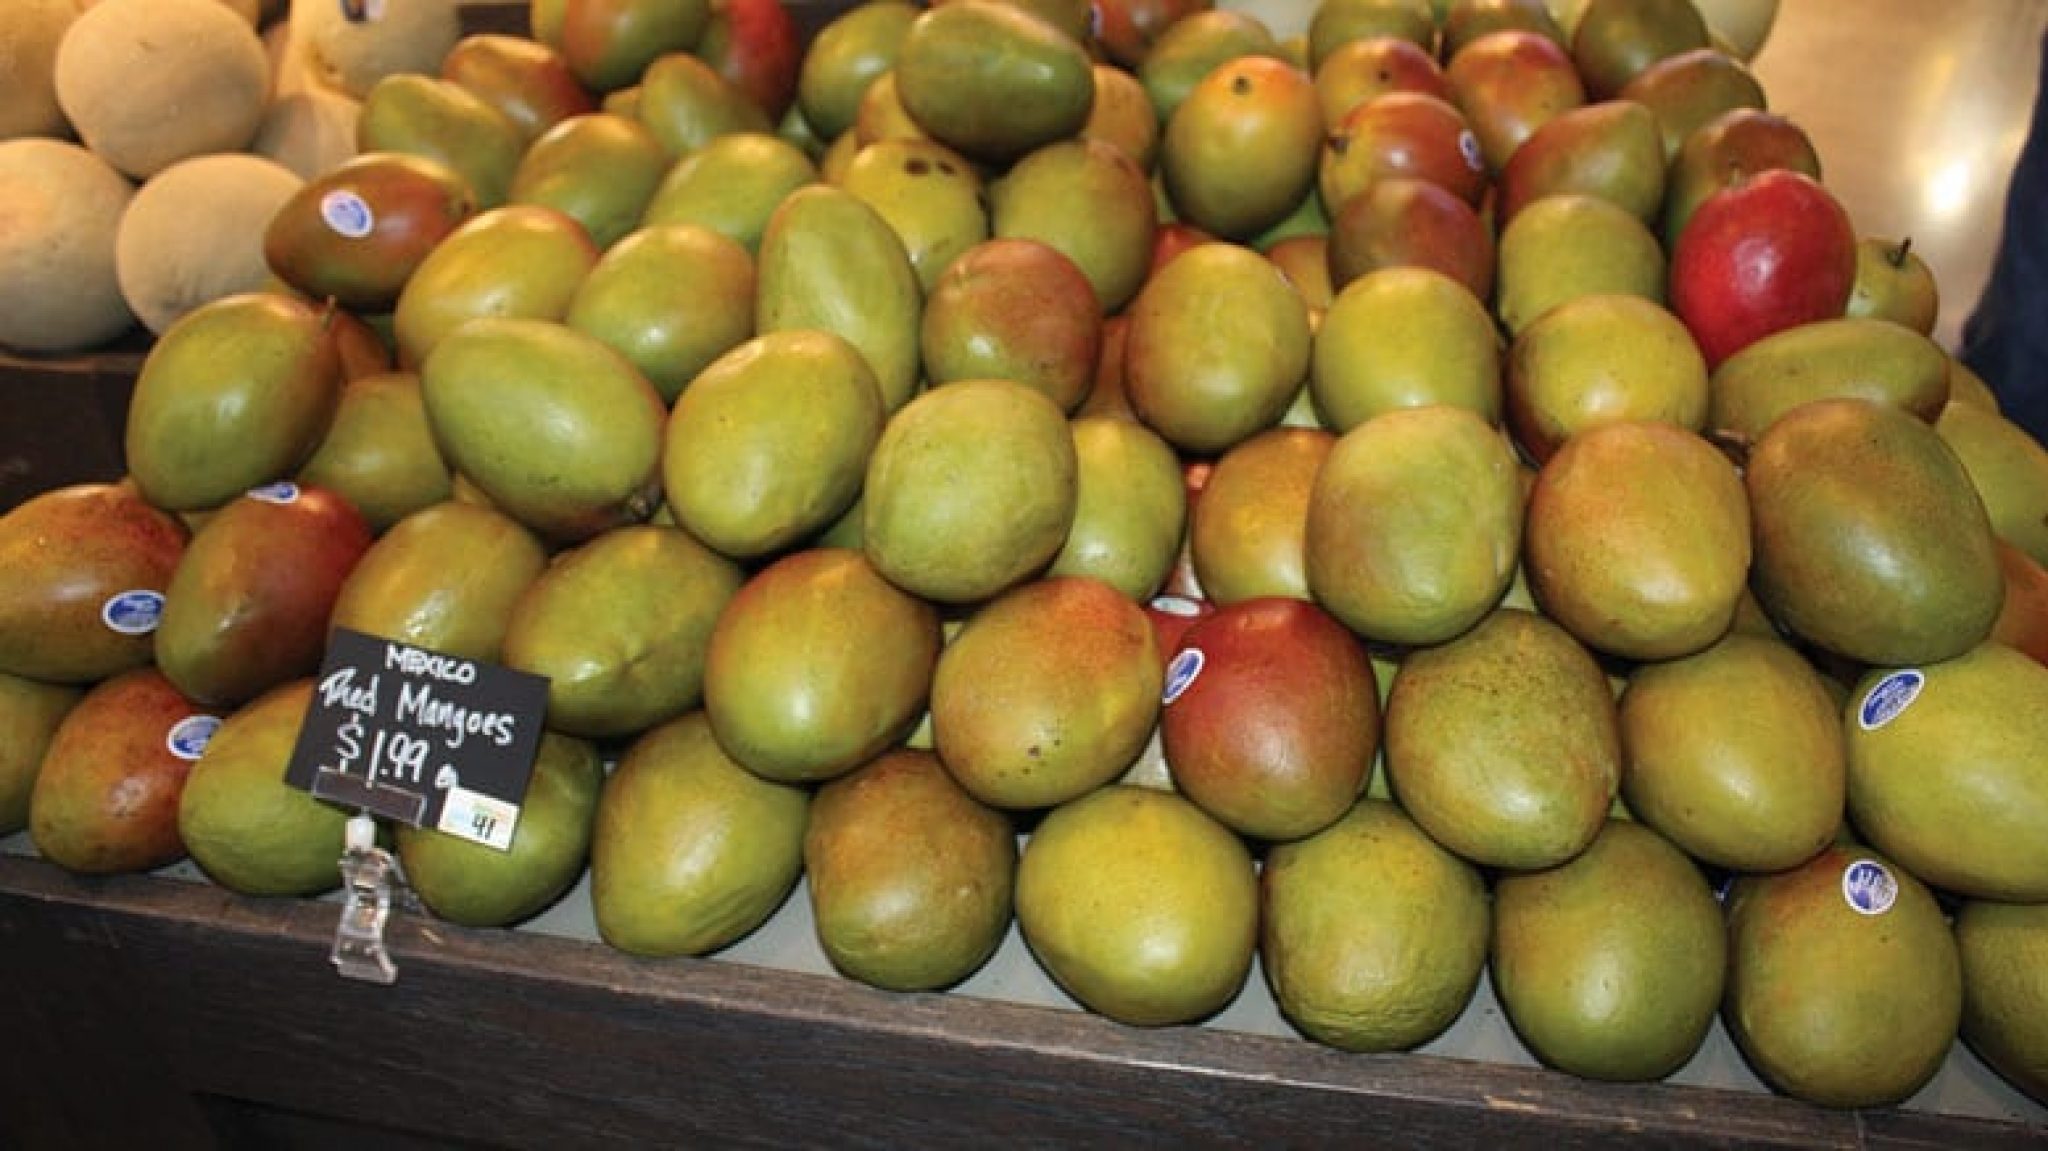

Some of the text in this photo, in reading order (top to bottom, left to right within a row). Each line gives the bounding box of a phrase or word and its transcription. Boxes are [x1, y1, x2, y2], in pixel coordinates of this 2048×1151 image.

[385, 642, 476, 686] MEXICO
[395, 681, 515, 748] Mangoes
[471, 813, 497, 841] 41
